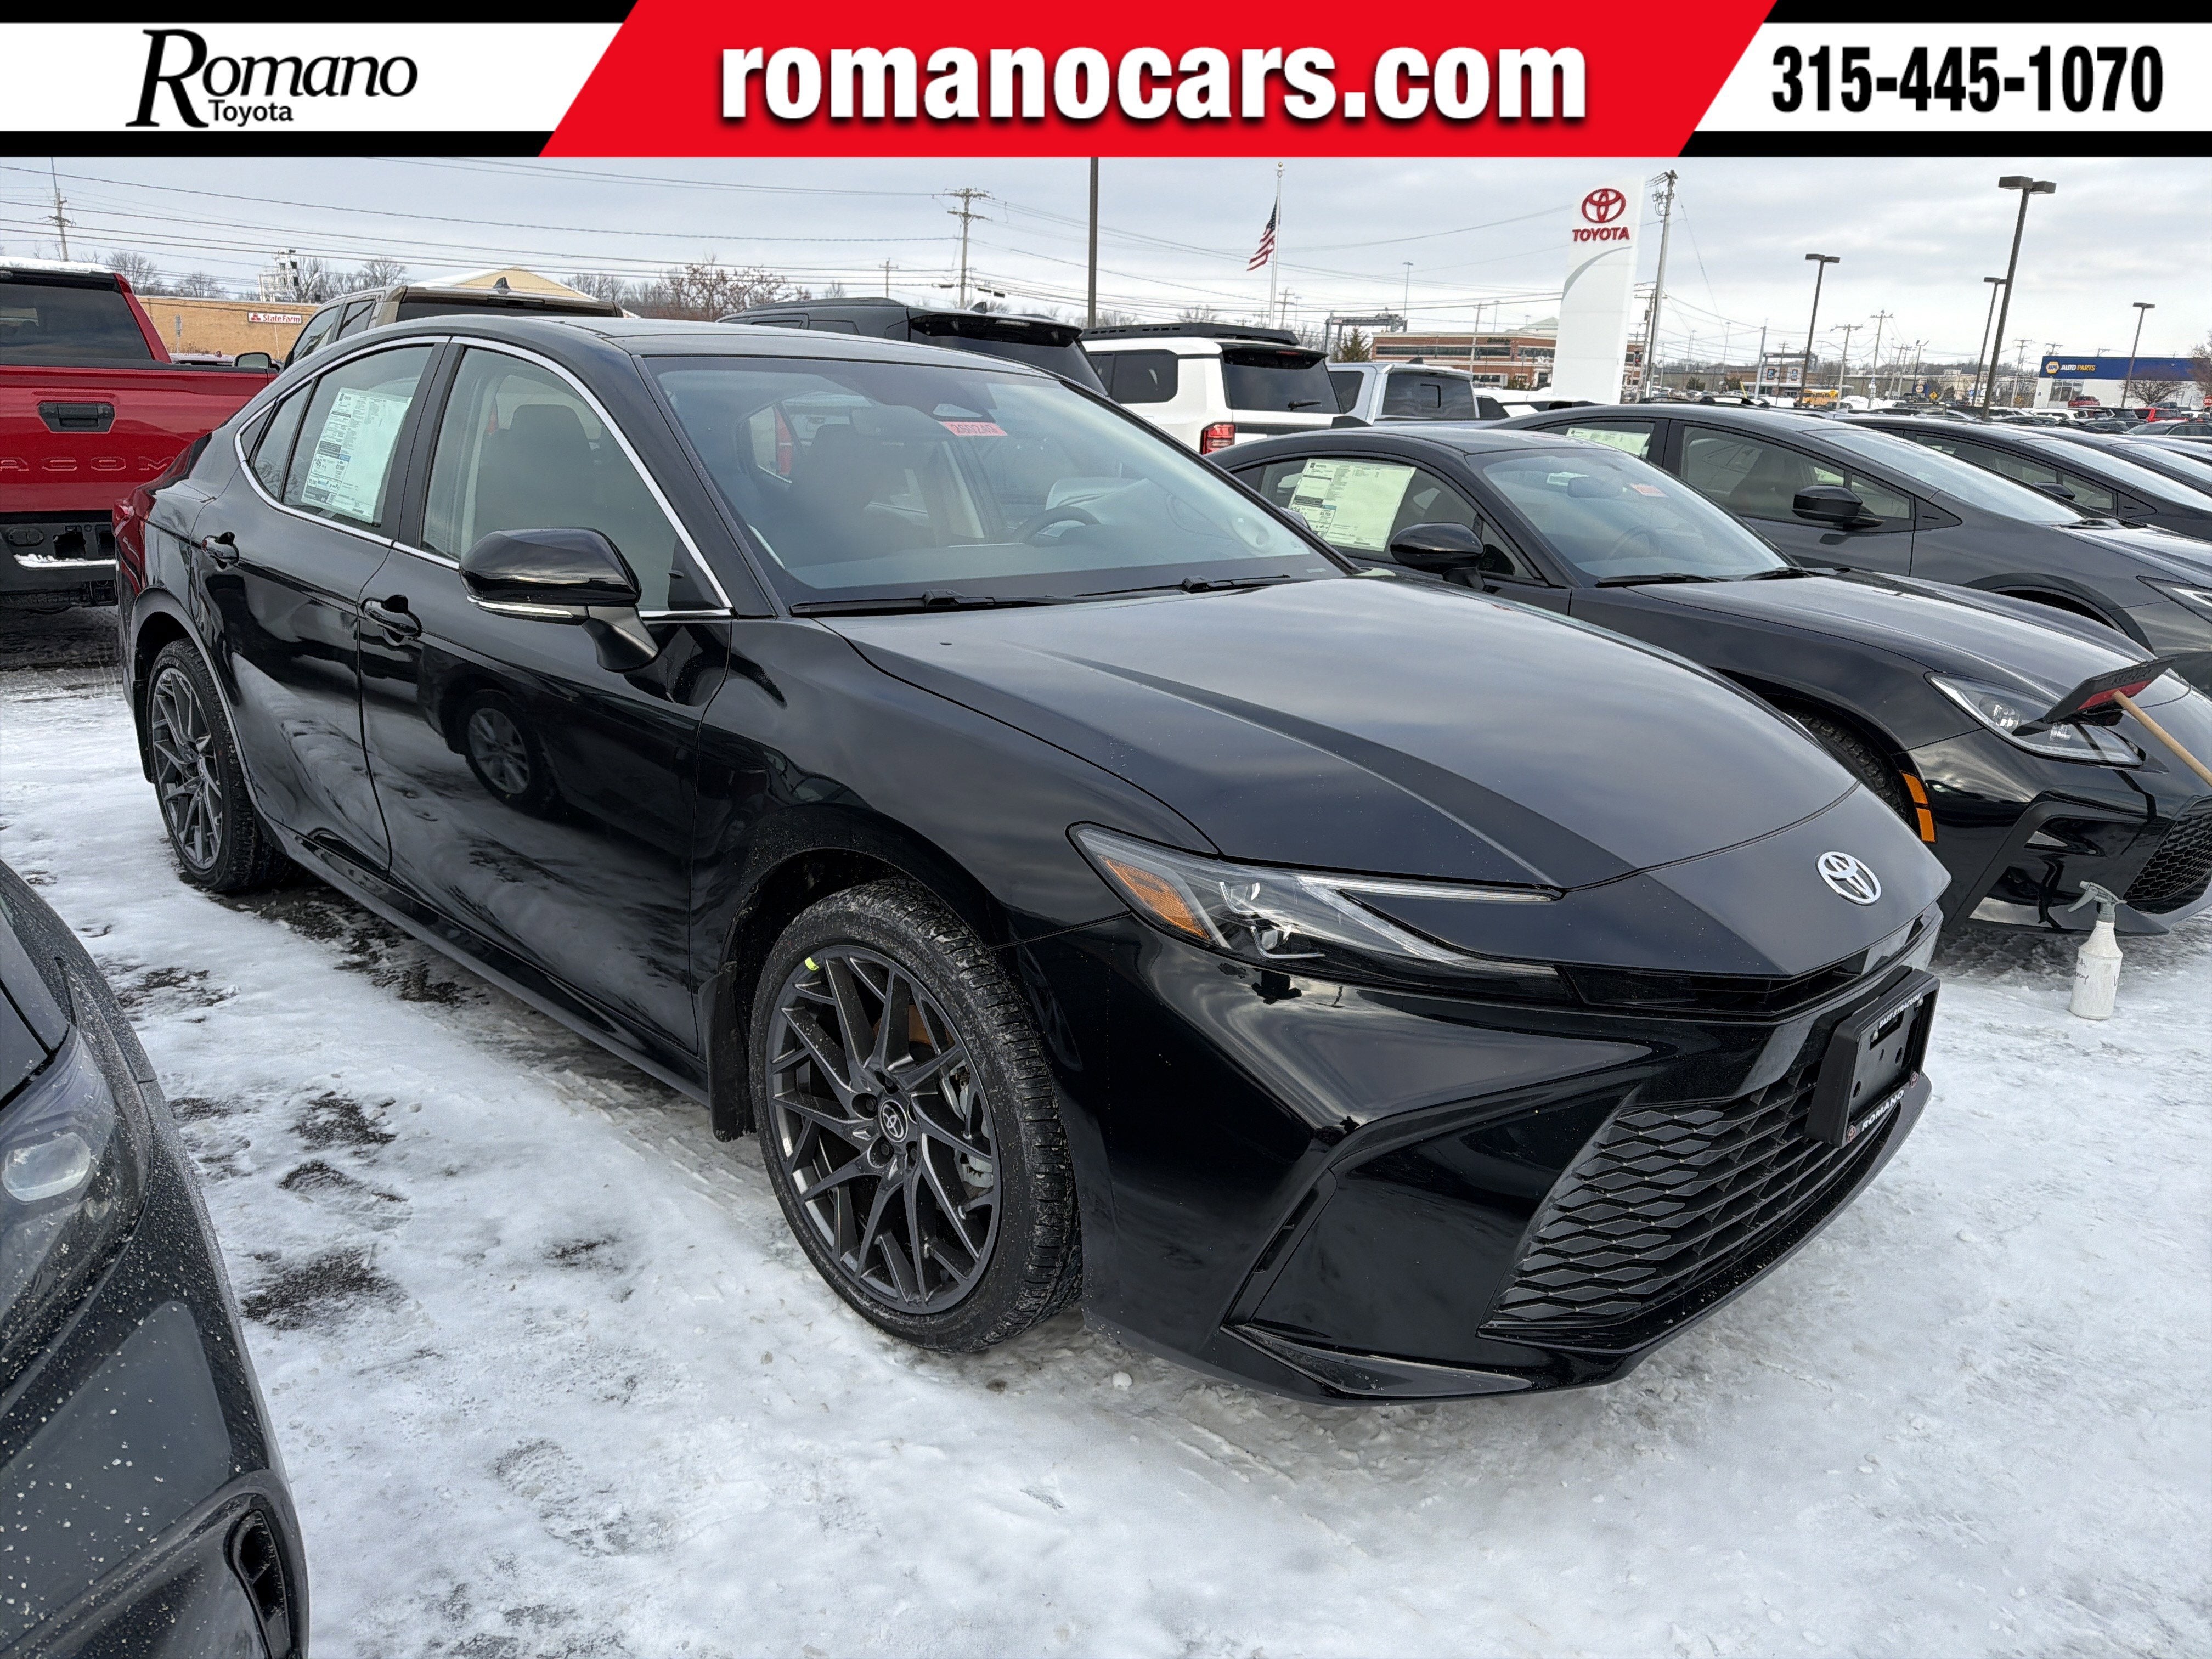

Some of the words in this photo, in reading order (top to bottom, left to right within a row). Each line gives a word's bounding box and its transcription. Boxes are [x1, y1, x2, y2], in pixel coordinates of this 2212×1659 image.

[1572, 227, 1630, 242] TOYOTA
[1878, 1012, 1893, 1029] EAST
[1893, 992, 1922, 1018] SYRACUSE
[1861, 1089, 1904, 1132] ROMANO
